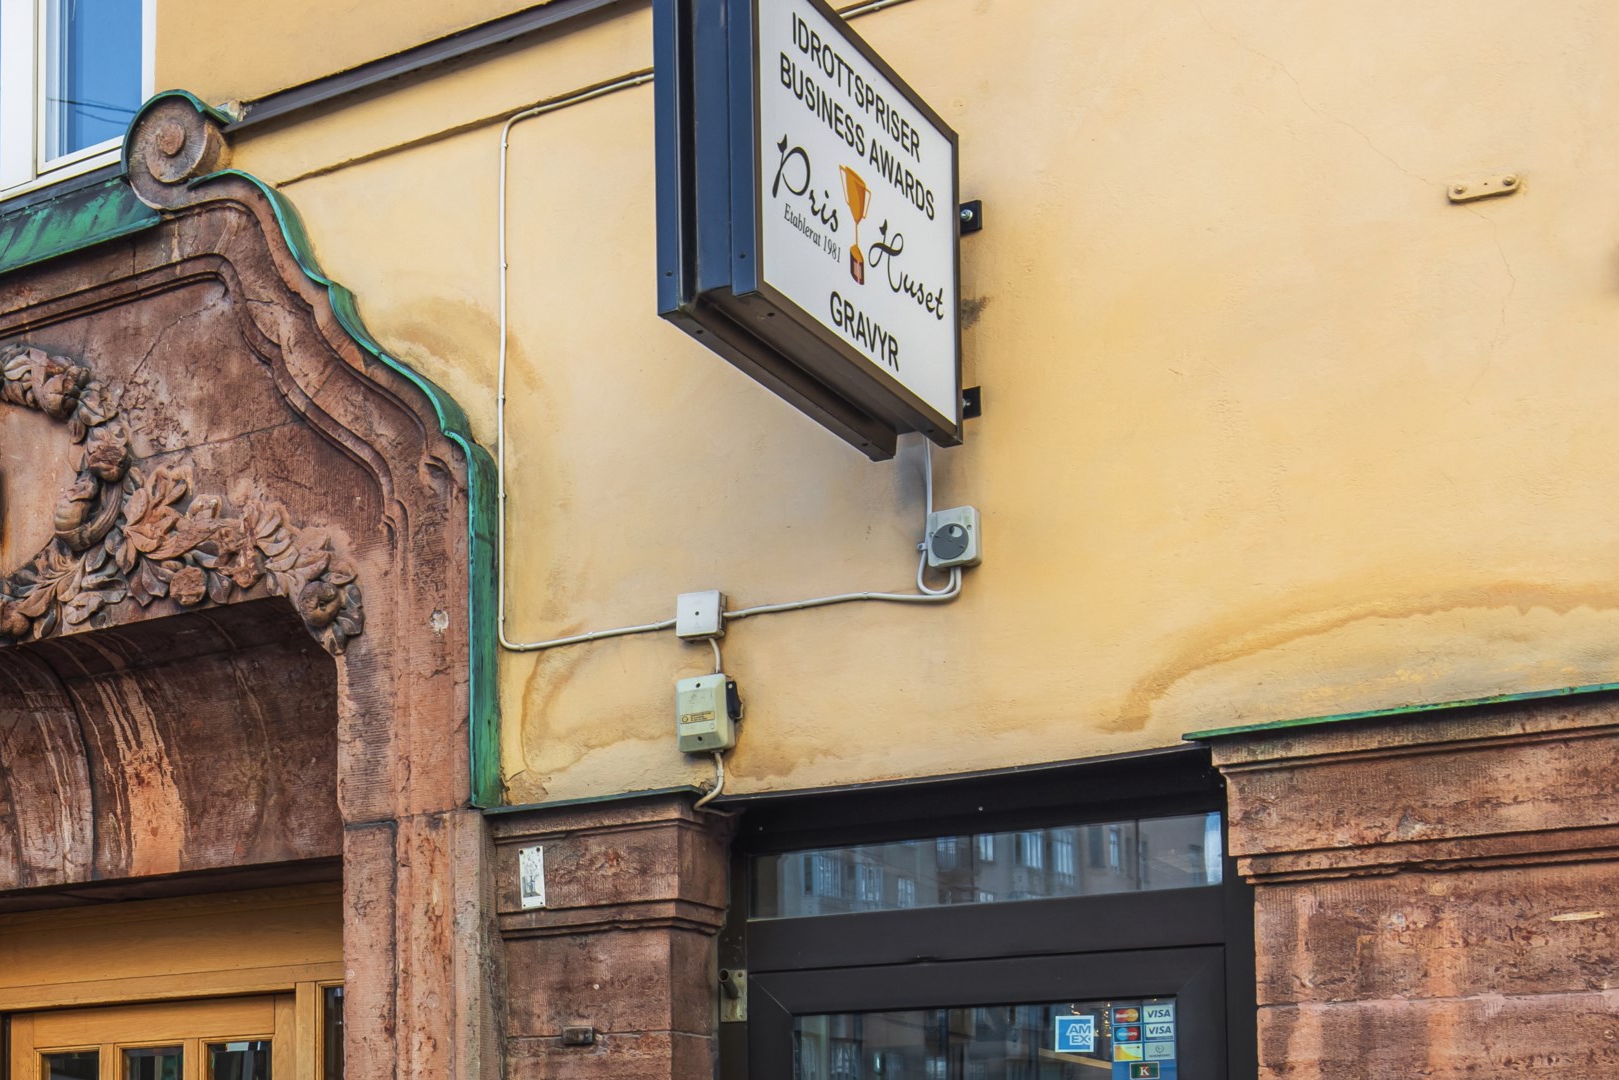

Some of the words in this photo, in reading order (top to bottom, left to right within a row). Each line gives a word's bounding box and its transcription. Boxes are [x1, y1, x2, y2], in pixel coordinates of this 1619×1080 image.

[792, 12, 920, 163] IDROTTSPRISER
[780, 52, 865, 157] BUSINESS
[870, 140, 935, 221] AWARDS
[772, 133, 839, 233] Pris
[868, 218, 944, 320] Huset
[784, 203, 821, 247] Etablerat
[823, 236, 841, 263] 1981
[830, 290, 899, 372] GRAVYR
[1147, 1009, 1171, 1018] VISA
[1148, 1026, 1172, 1035] VISA
